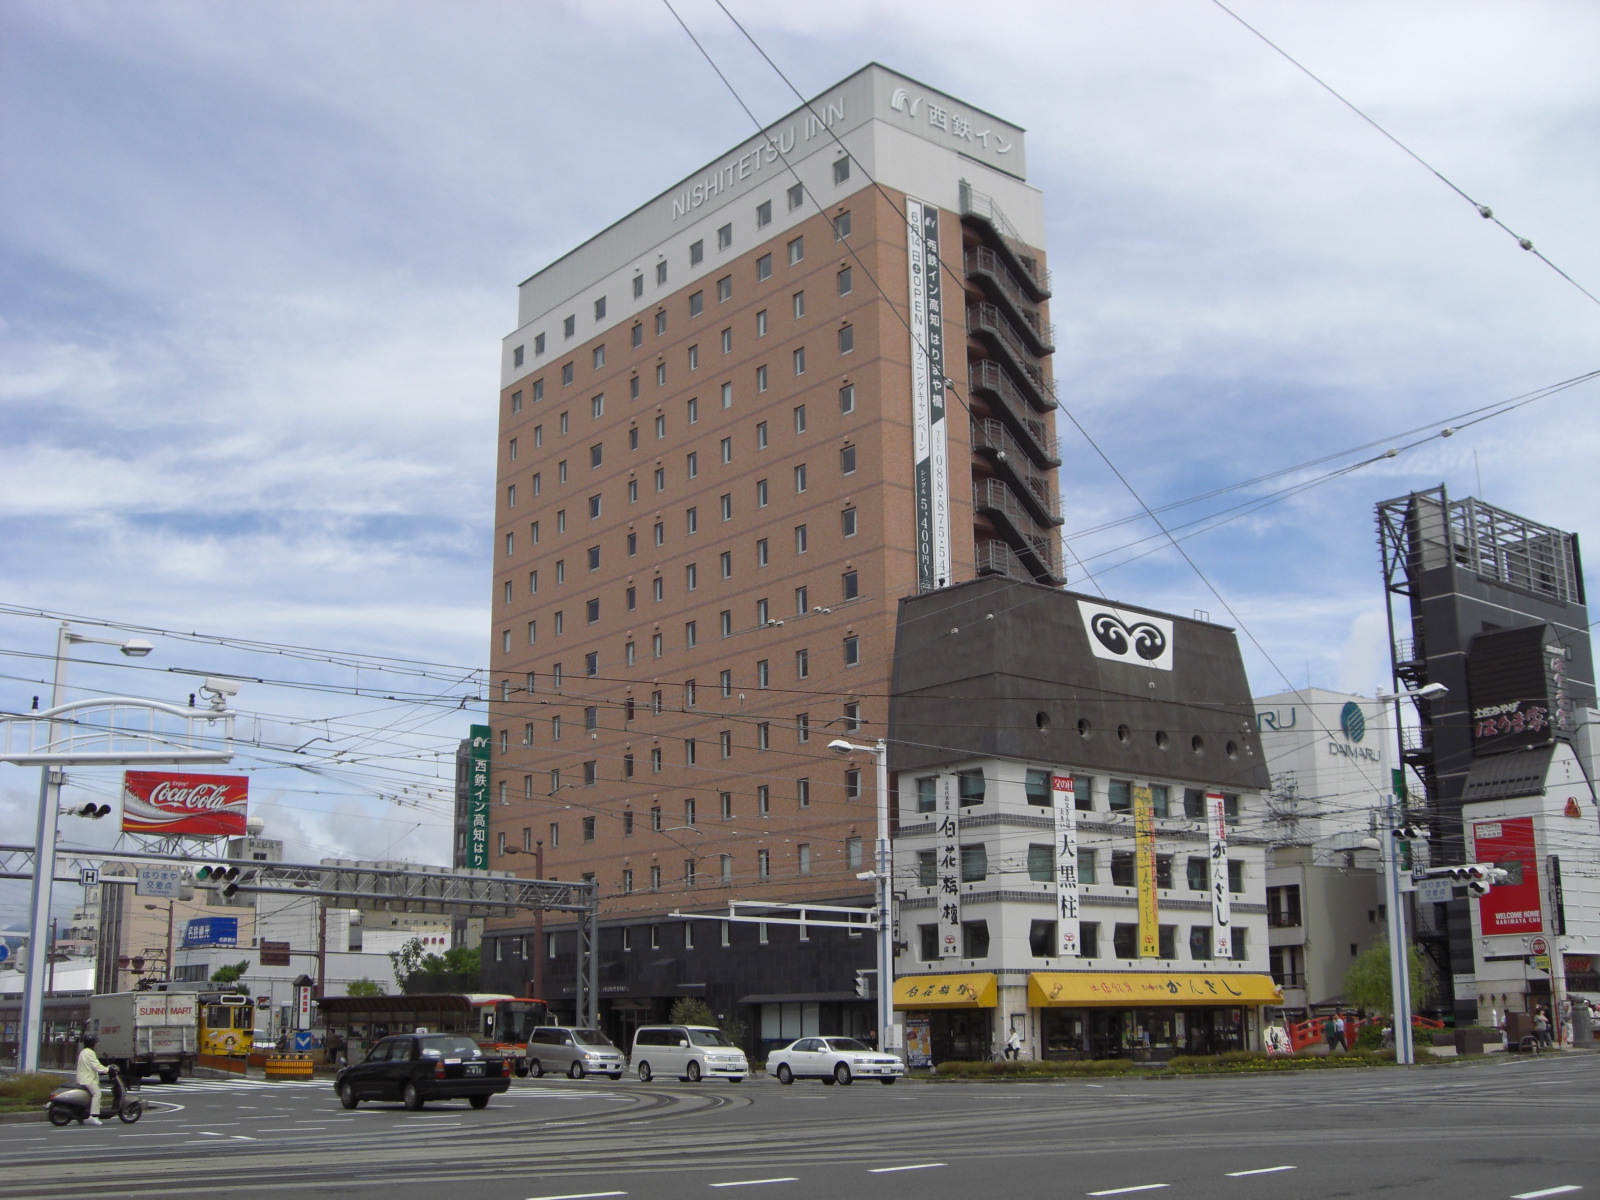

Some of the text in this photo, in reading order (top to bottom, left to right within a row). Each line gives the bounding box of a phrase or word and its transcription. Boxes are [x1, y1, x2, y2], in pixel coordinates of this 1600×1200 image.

[928, 103, 1012, 153] 西鉄イン
[672, 96, 846, 221] NISHITETSU INN
[1328, 742, 1380, 761] DAIMARU
[149, 782, 231, 809] Coca-Cola
[472, 759, 487, 869] 西鉄イン高知はり
[85, 871, 95, 882] H
[142, 871, 178, 880] はりまや
[1058, 834, 1077, 919] 大黒柱
[1416, 864, 1422, 876] H
[146, 881, 173, 890] 交差点
[1212, 841, 1228, 926] かんざし
[1421, 880, 1449, 889] はりまや
[1495, 909, 1540, 920] WELCOME HOME
[1495, 916, 1541, 926] HARIMAYA CHO
[1166, 979, 1242, 996] かんざし
[140, 1006, 193, 1016] SUNNY MART
